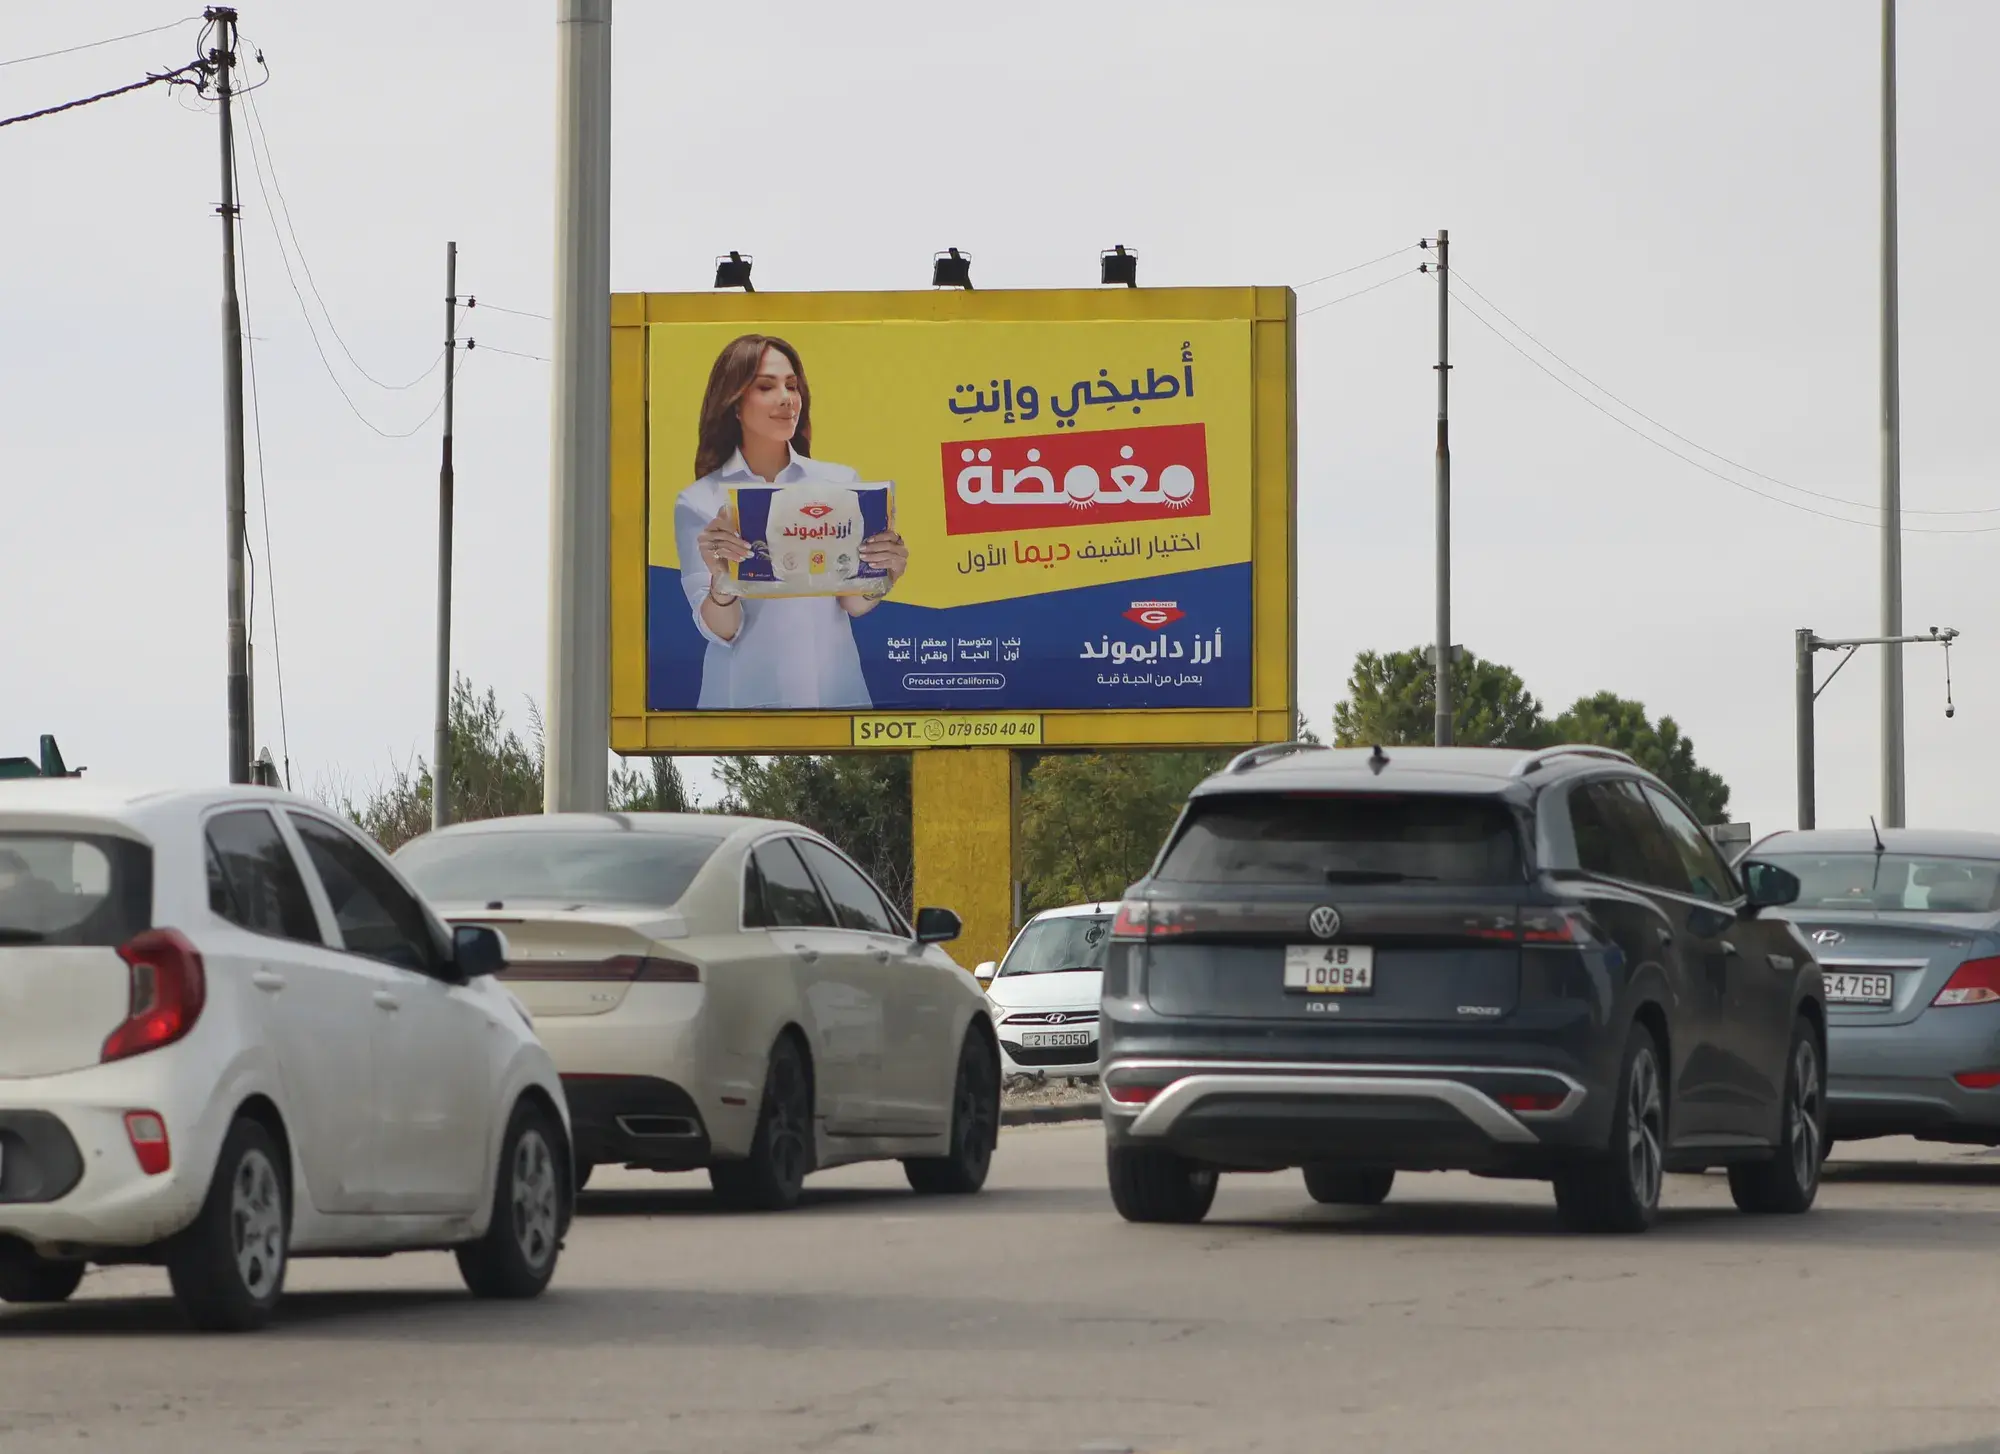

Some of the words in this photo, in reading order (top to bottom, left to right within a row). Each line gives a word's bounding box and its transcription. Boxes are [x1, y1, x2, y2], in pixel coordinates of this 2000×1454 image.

[956, 444, 1196, 510] مغمضة
[783, 522, 836, 540] دايموند
[1076, 537, 1141, 563] الشيف
[1145, 533, 1201, 560] اختيار
[957, 544, 1007, 574] الأول
[1013, 540, 1071, 569] ديما
[887, 637, 911, 648] نكهة
[920, 637, 947, 649] معقم
[957, 637, 993, 648] متوسط
[1001, 636, 1021, 647] نخب
[1190, 627, 1222, 664] أرز
[888, 650, 911, 662] غنية
[1003, 648, 1020, 661] أول
[1080, 634, 1184, 665] دايموند
[920, 651, 948, 664] ونقي
[960, 650, 990, 663] الحبة
[908, 677, 944, 686] Product
[946, 677, 955, 686] of
[956, 676, 1000, 686] California
[1122, 673, 1153, 687] الحبة
[1154, 674, 1171, 687] من
[860, 721, 917, 739] SPOT
[948, 722, 971, 736] 079
[974, 722, 998, 736] 650
[1000, 722, 1016, 736] 40
[1019, 722, 1035, 736] 40
